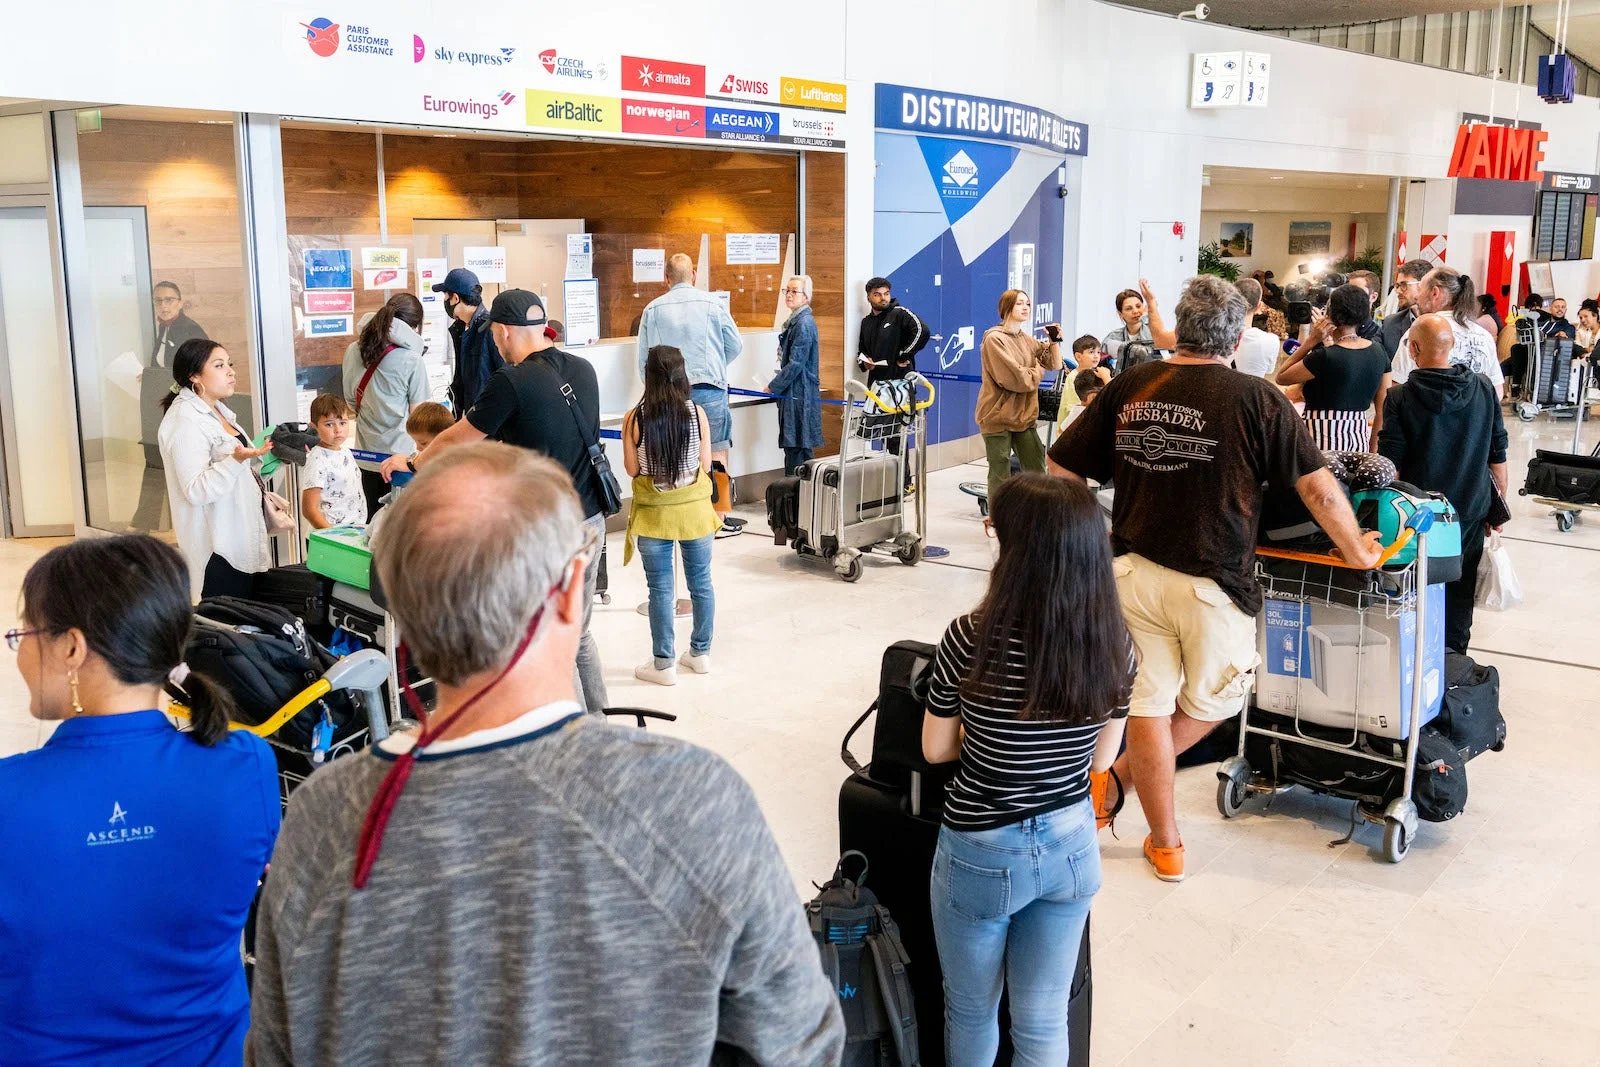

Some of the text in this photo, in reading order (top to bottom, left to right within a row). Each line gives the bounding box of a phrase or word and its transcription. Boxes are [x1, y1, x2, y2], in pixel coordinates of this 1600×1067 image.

[346, 25, 369, 34] PARIS
[346, 34, 389, 46] CUSTOMER
[346, 44, 394, 56] ASSISTANCE
[434, 46, 503, 66] sky express
[557, 57, 584, 68] CZECH
[556, 67, 593, 79] AIRLINES
[735, 79, 769, 95] SWISS
[800, 86, 844, 103] Lufthansa
[423, 95, 498, 120] Eurowings
[546, 100, 603, 122] airBaltic
[626, 104, 690, 121] norwegian
[712, 112, 763, 128] AEGEAN
[792, 117, 822, 130] brussels
[902, 92, 1081, 151] DISTRIBUTEUR DE BILLETS
[721, 131, 760, 142] STAR ALLIANCE
[949, 161, 974, 175] Euronet
[942, 189, 979, 197] WORLDWIDE
[373, 254, 399, 263] airBaltic
[467, 258, 493, 267] brussels
[310, 265, 340, 274] AEGEAN
[1036, 302, 1054, 325] ATM
[1123, 401, 1203, 419] HARLEY-DAVIDSON
[1117, 408, 1207, 433] WIESBADEN
[1166, 440, 1208, 455] CYCLES
[1152, 462, 1189, 472] GERMANY
[1267, 610, 1281, 619] 30L
[86, 825, 157, 842] ASCEND
